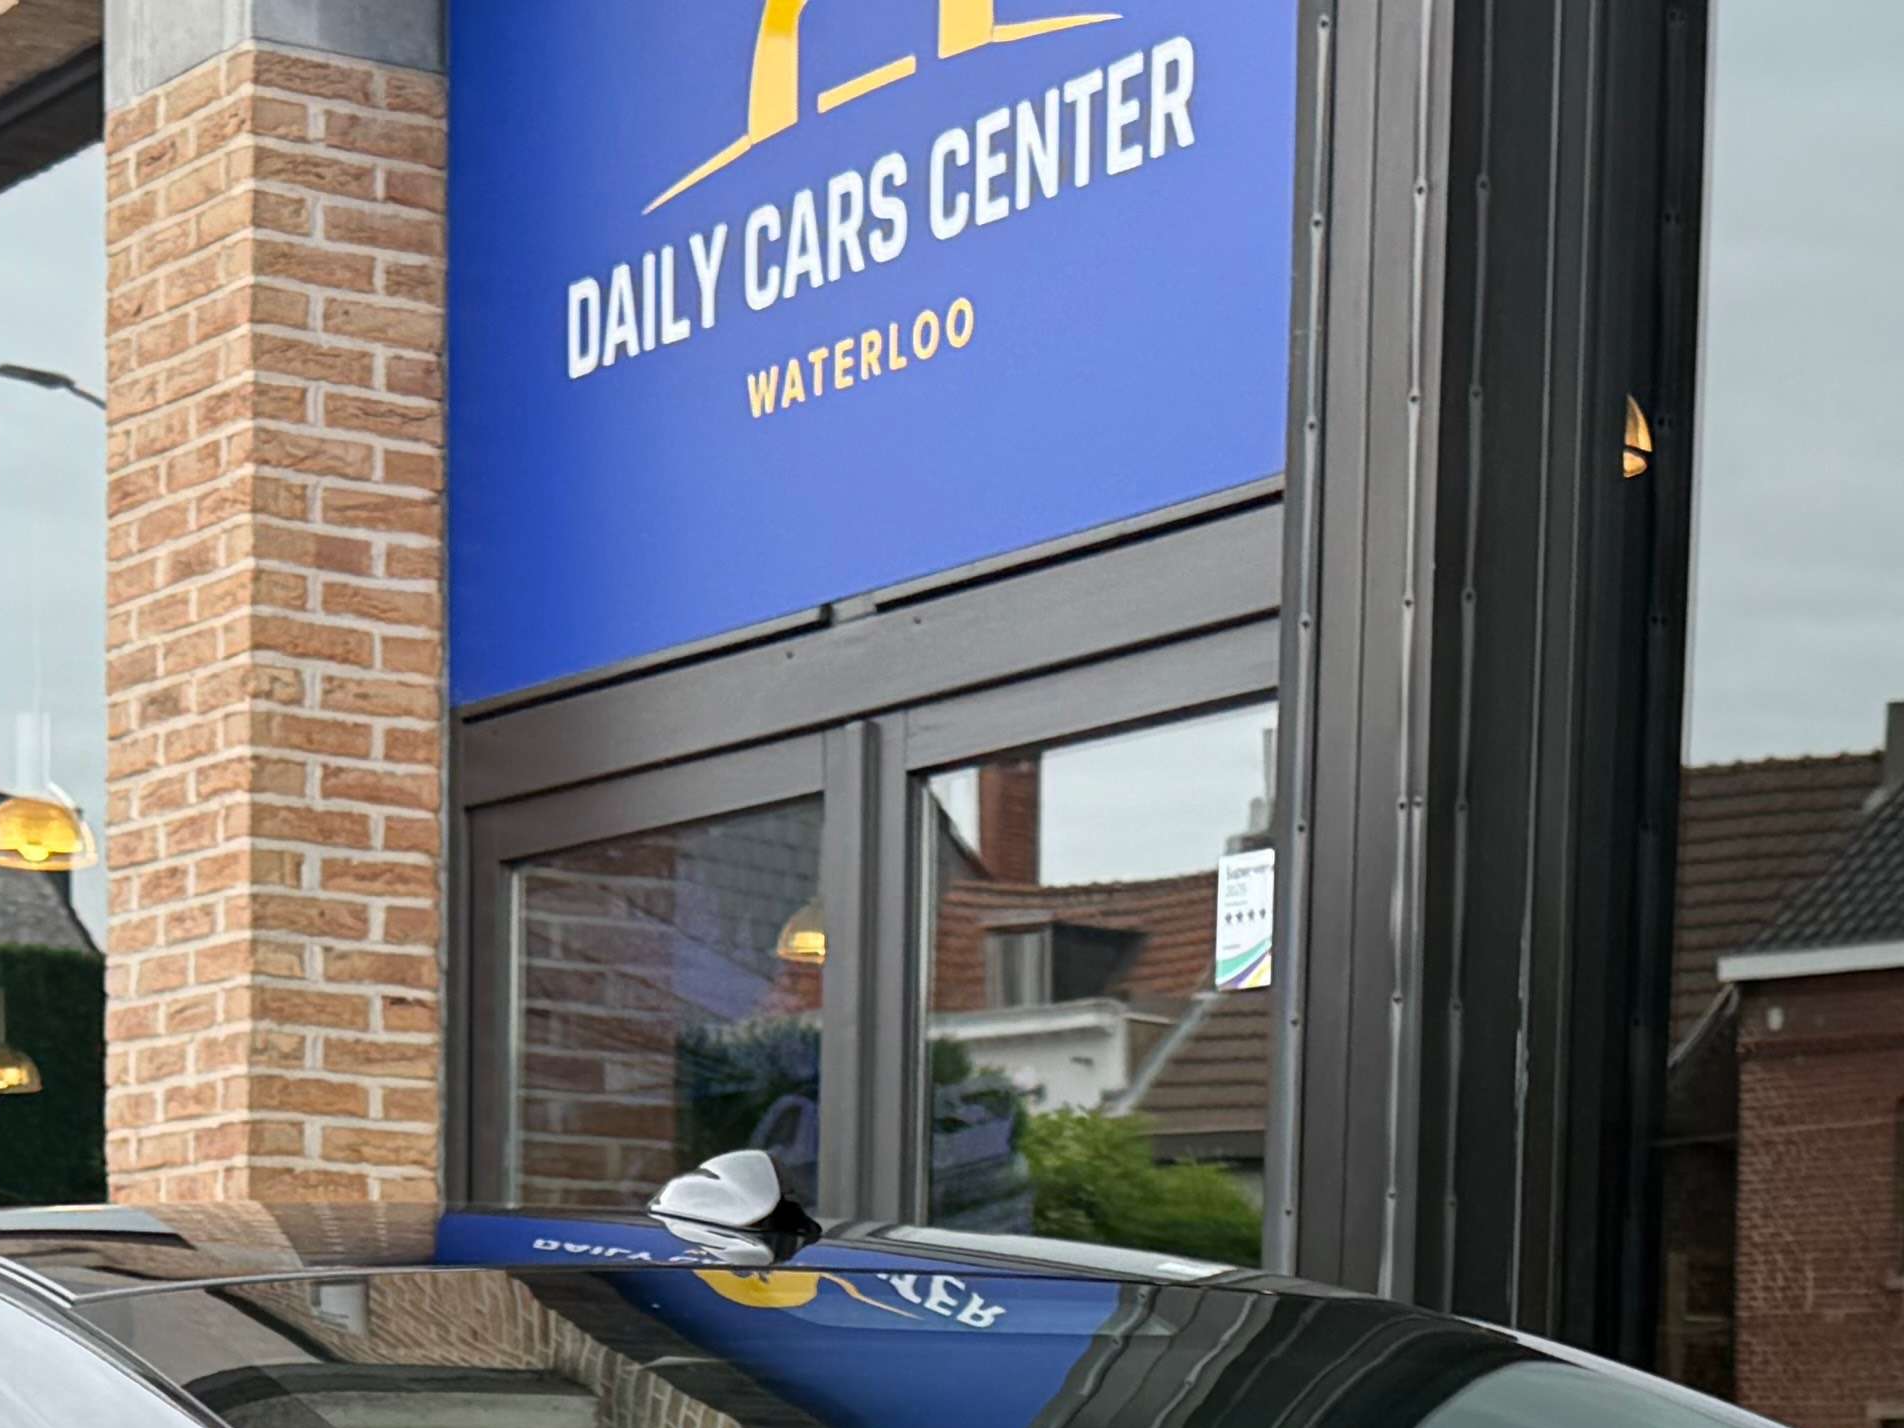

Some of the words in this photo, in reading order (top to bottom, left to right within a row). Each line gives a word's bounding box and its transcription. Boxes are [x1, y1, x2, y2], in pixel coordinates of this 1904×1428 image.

[567, 222, 728, 381] DAILY
[743, 150, 909, 312] CARS
[929, 35, 1196, 242] CENTER
[747, 297, 975, 419] WATERLOO
